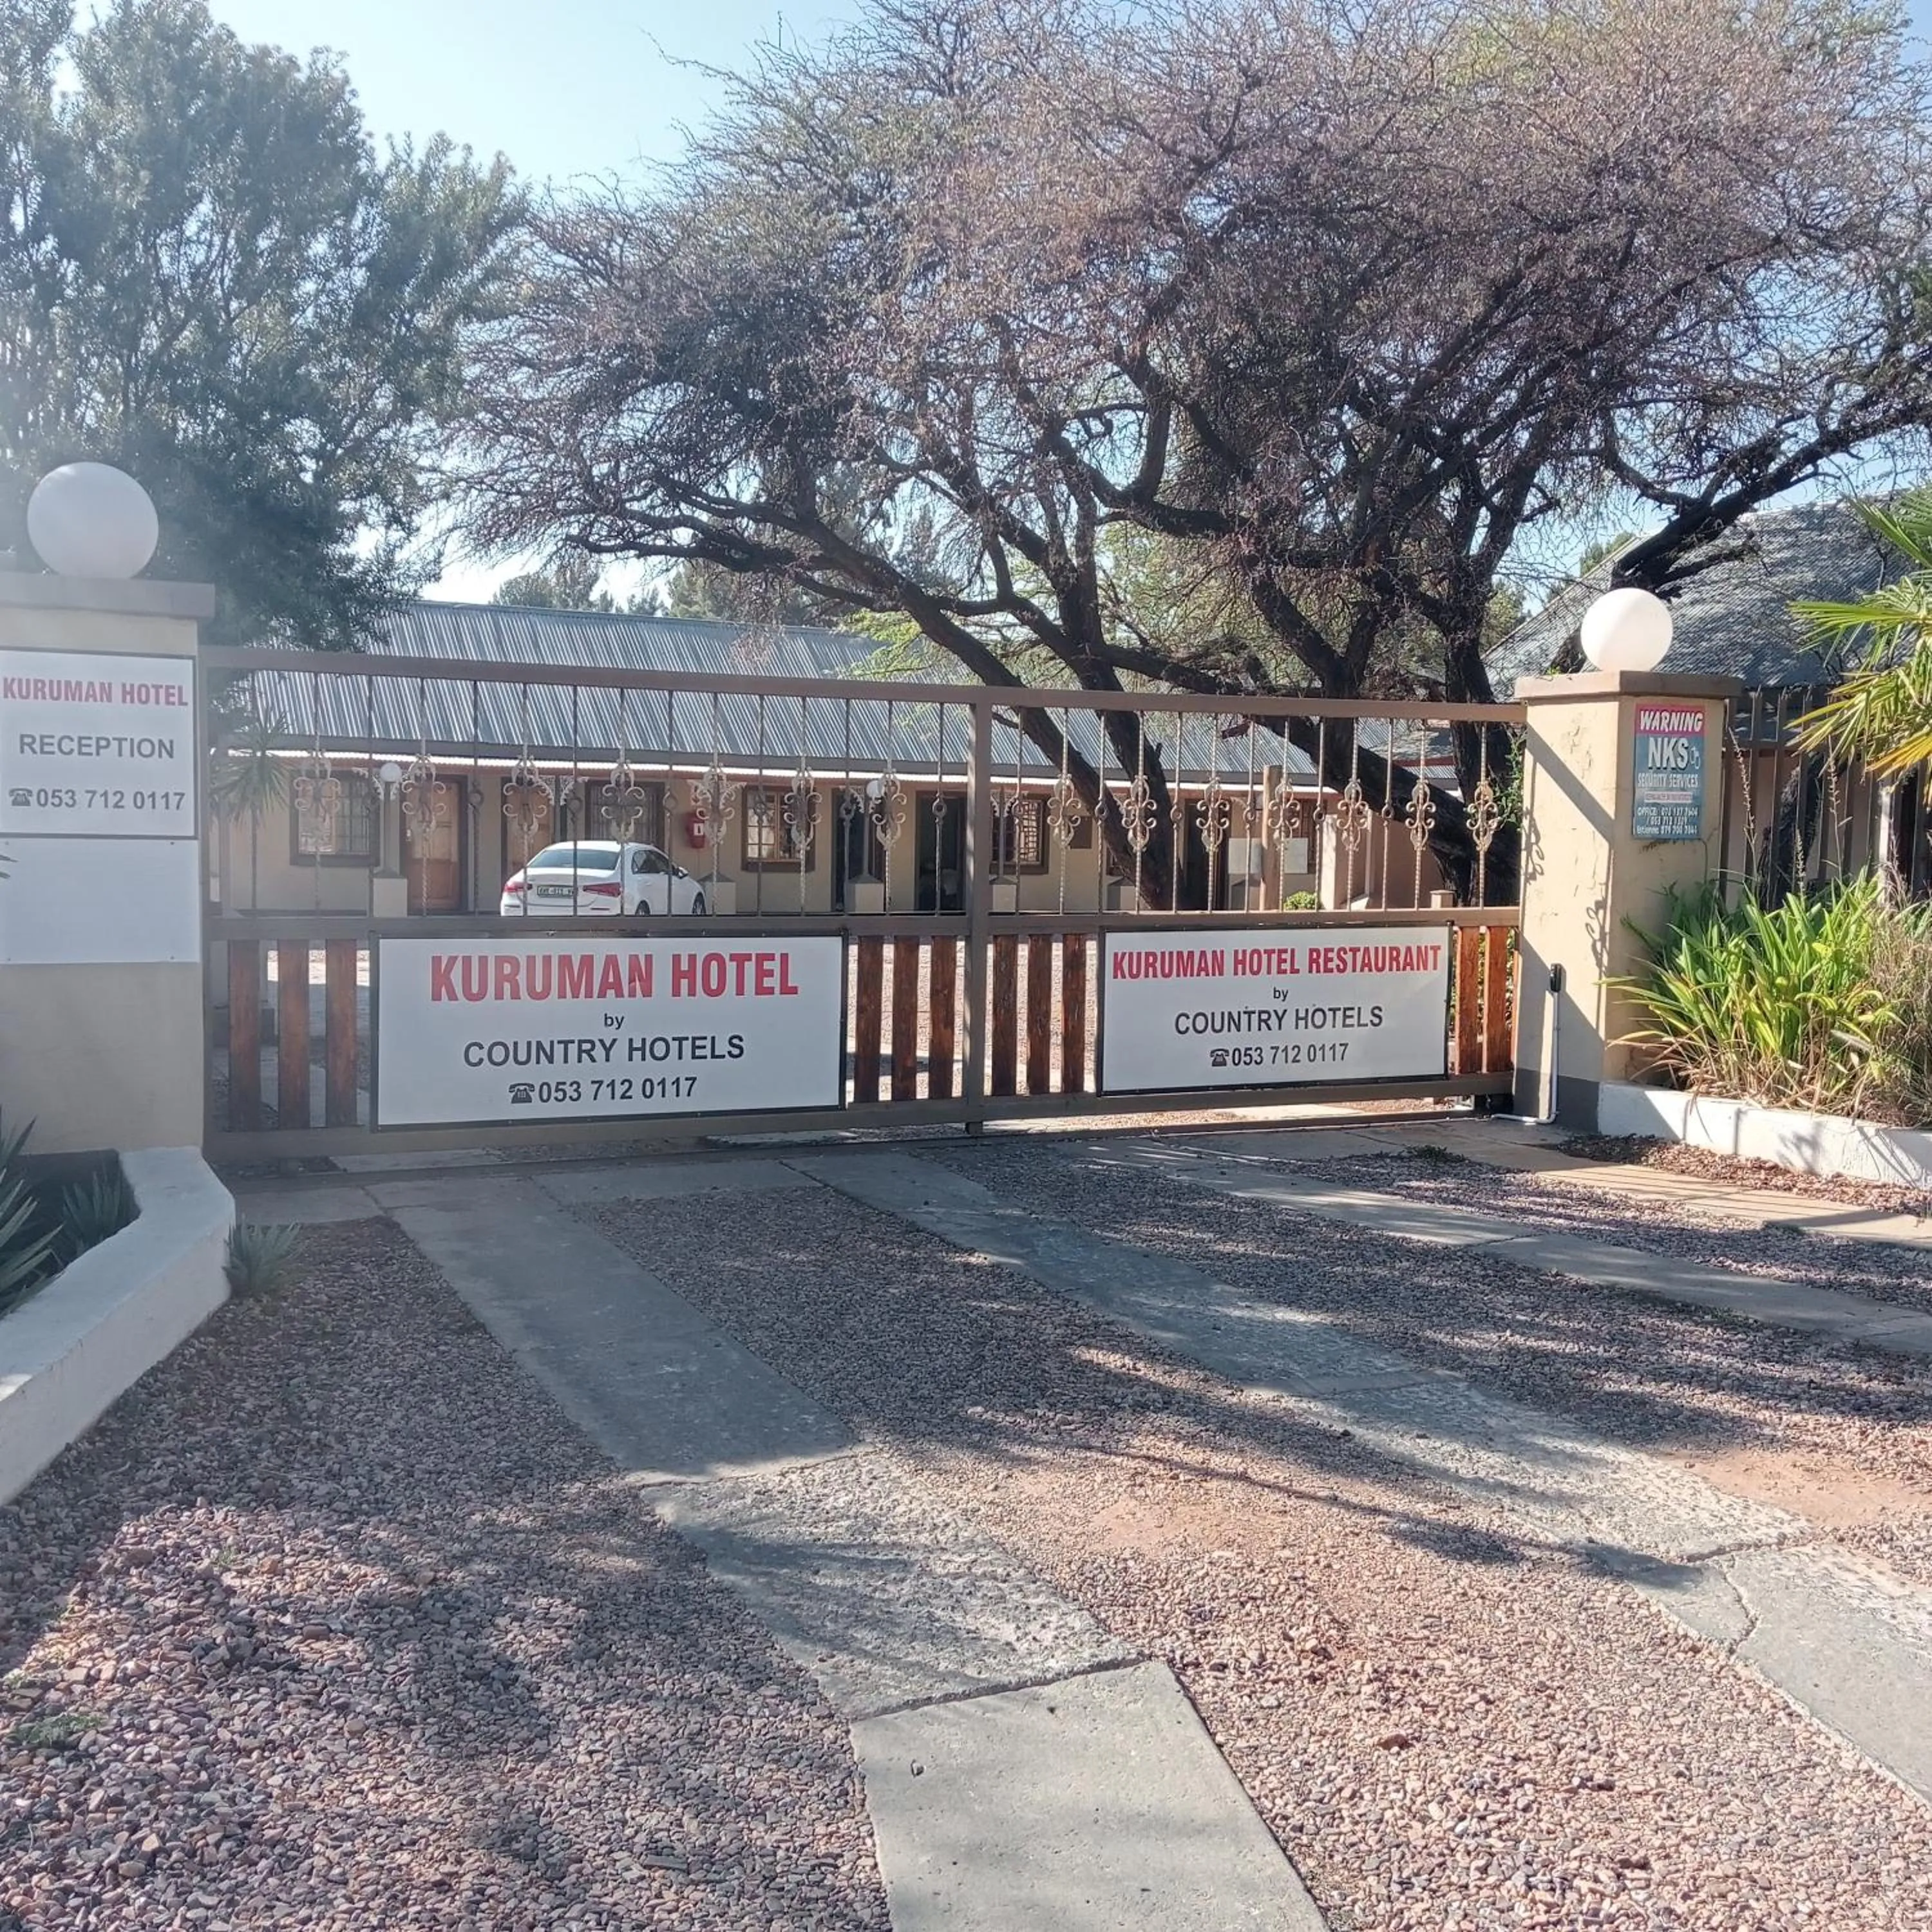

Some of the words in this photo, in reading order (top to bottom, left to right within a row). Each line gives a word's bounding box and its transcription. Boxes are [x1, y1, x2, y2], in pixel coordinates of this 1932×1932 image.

[3, 677, 113, 703] KURUMAN
[121, 683, 189, 706] HOTEL
[1640, 710, 1703, 732] WARNING
[19, 734, 175, 759] RECEPTION
[1648, 737, 1690, 770] NKS
[1638, 772, 1667, 787] SECURITY
[1669, 773, 1698, 789] SERVICES
[36, 788, 77, 808] 053
[84, 790, 125, 809] 712
[133, 791, 186, 811] 0117
[1112, 949, 1225, 980] KURUMAN
[1233, 947, 1300, 976] HOTEL
[1308, 945, 1442, 974] RESTAURANT
[431, 954, 653, 1001] KURUMAN
[671, 952, 799, 998] HOTEL
[1273, 987, 1289, 1002] by
[603, 1012, 625, 1030] by
[1175, 1009, 1288, 1035] COUNTRY
[1294, 1005, 1384, 1030] HOTELS
[463, 1038, 618, 1067] COUNTRY
[627, 1034, 744, 1063] HOTELS
[1231, 1046, 1264, 1066] 053
[1270, 1045, 1301, 1064] 712
[1307, 1043, 1349, 1063] 0117
[538, 1081, 582, 1103] 053
[591, 1079, 633, 1101] 712
[643, 1076, 698, 1099] 0117
